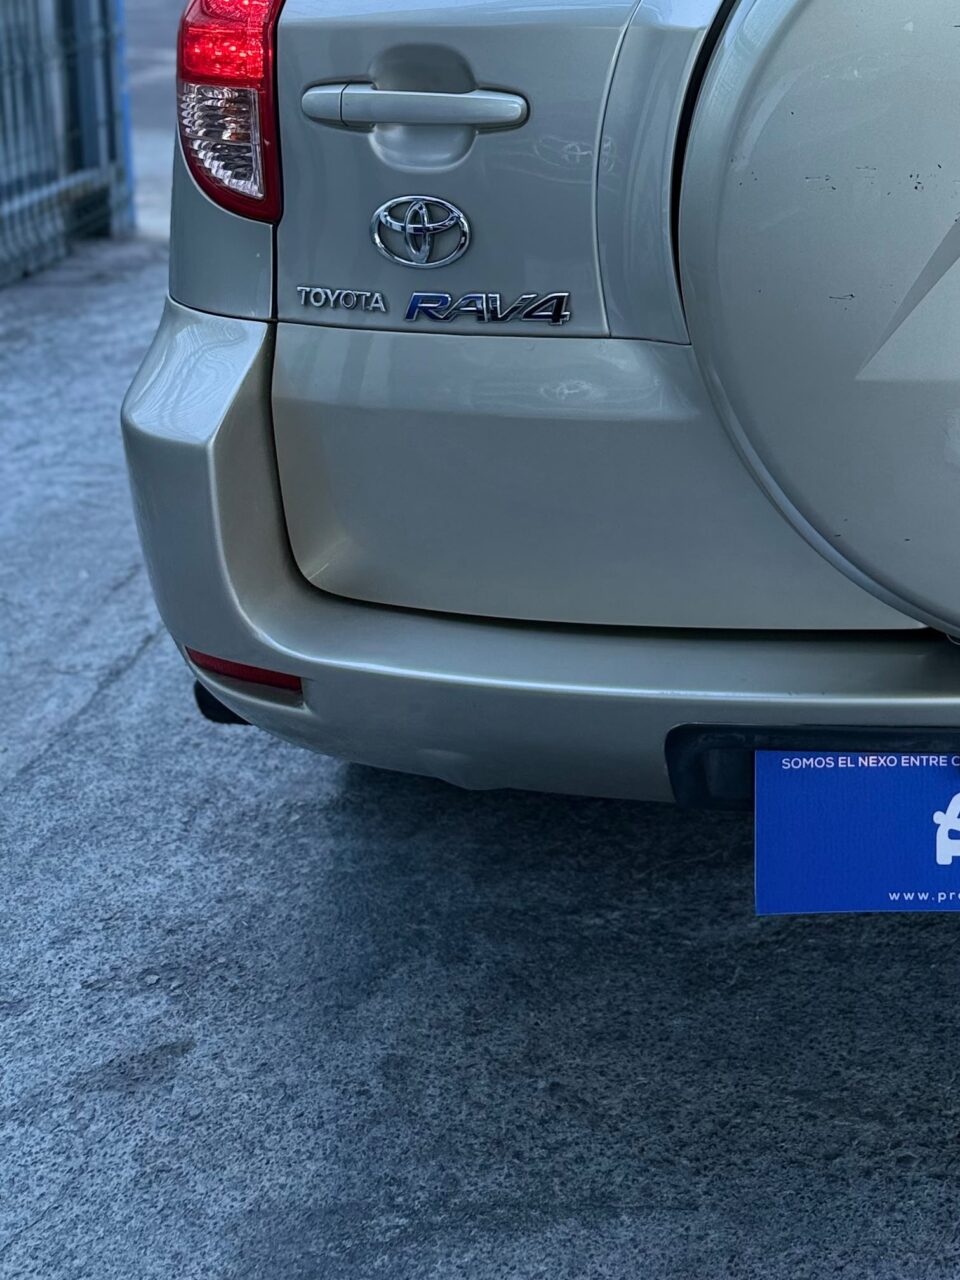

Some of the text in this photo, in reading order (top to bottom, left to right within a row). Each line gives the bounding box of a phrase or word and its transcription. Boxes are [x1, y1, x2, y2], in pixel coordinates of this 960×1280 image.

[297, 286, 572, 326] TOYOTA RAV4
[781, 756, 835, 770] SOMOS
[838, 755, 855, 768] EL
[857, 755, 898, 768] NEXO
[901, 754, 948, 767] ENTRE
